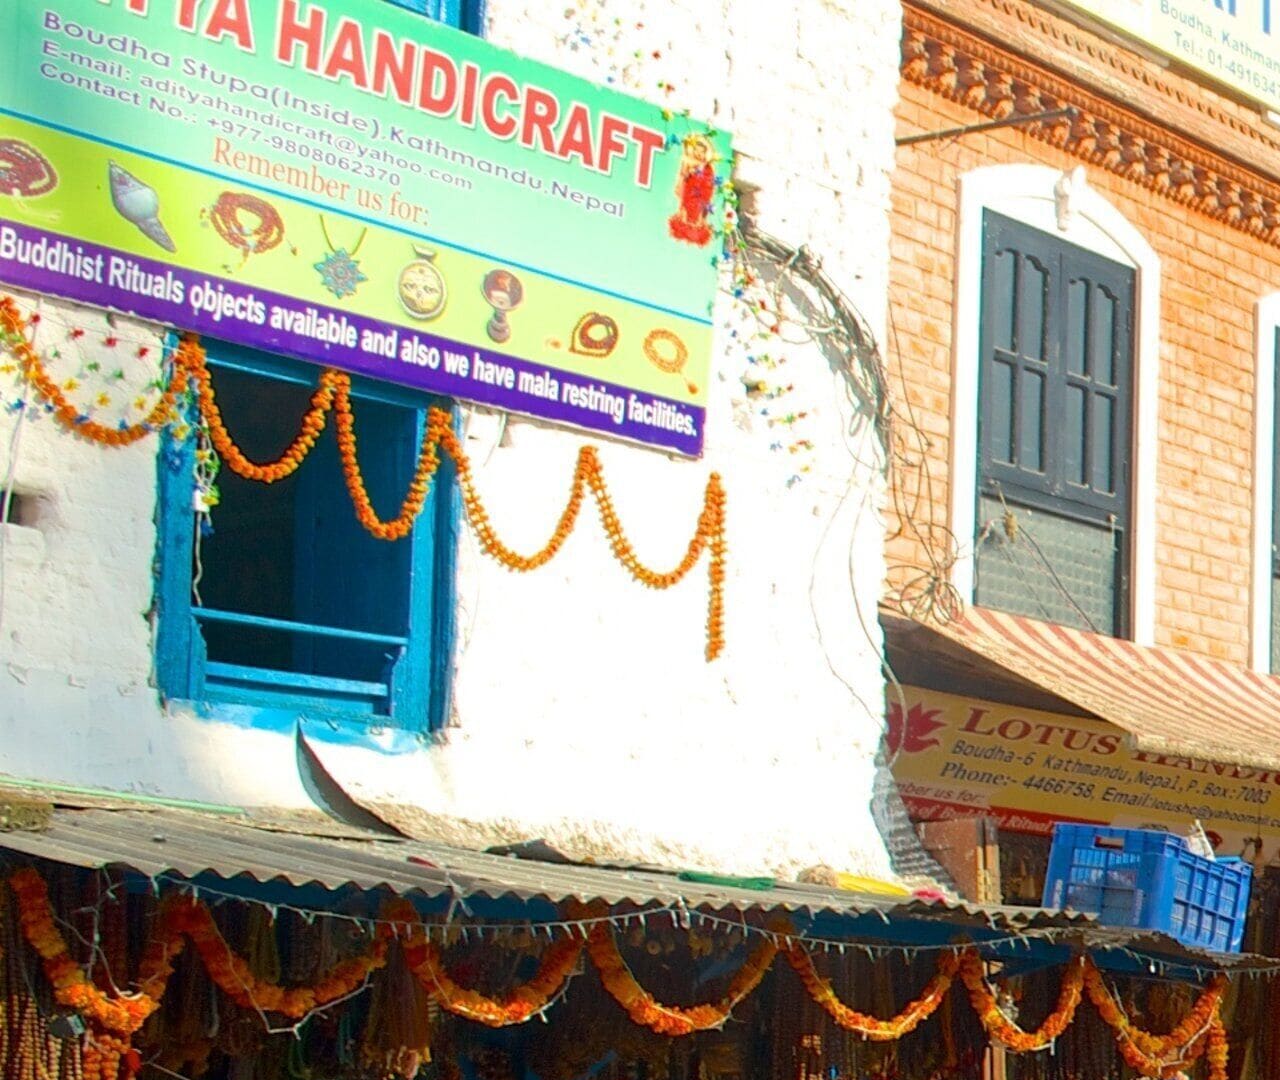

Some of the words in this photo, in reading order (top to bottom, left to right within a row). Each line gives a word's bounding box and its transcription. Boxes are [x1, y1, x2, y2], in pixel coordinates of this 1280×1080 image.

[43, 11, 171, 68] Boudha
[40, 62, 140, 106] Contact
[207, 117, 401, 186] +977-9808062370
[42, 39, 131, 81] E-mail:
[140, 74, 473, 189] adityahandicraft@yahoo.com
[277, 0, 664, 186] HANDICRAFT
[213, 137, 349, 201] Remember
[357, 188, 383, 211] us
[389, 192, 430, 226] for:
[0, 226, 103, 283] Buddhist
[109, 255, 184, 304] Rituals
[190, 281, 266, 325] objects
[270, 304, 357, 350] available
[361, 328, 397, 359] and
[400, 338, 440, 369] also
[444, 352, 470, 377] we
[473, 351, 516, 389] have
[518, 369, 559, 401] mala
[561, 379, 625, 425] restring
[628, 395, 697, 437] facilities.
[951, 739, 1037, 766] Boudha-6
[958, 706, 1121, 756] LOTUS
